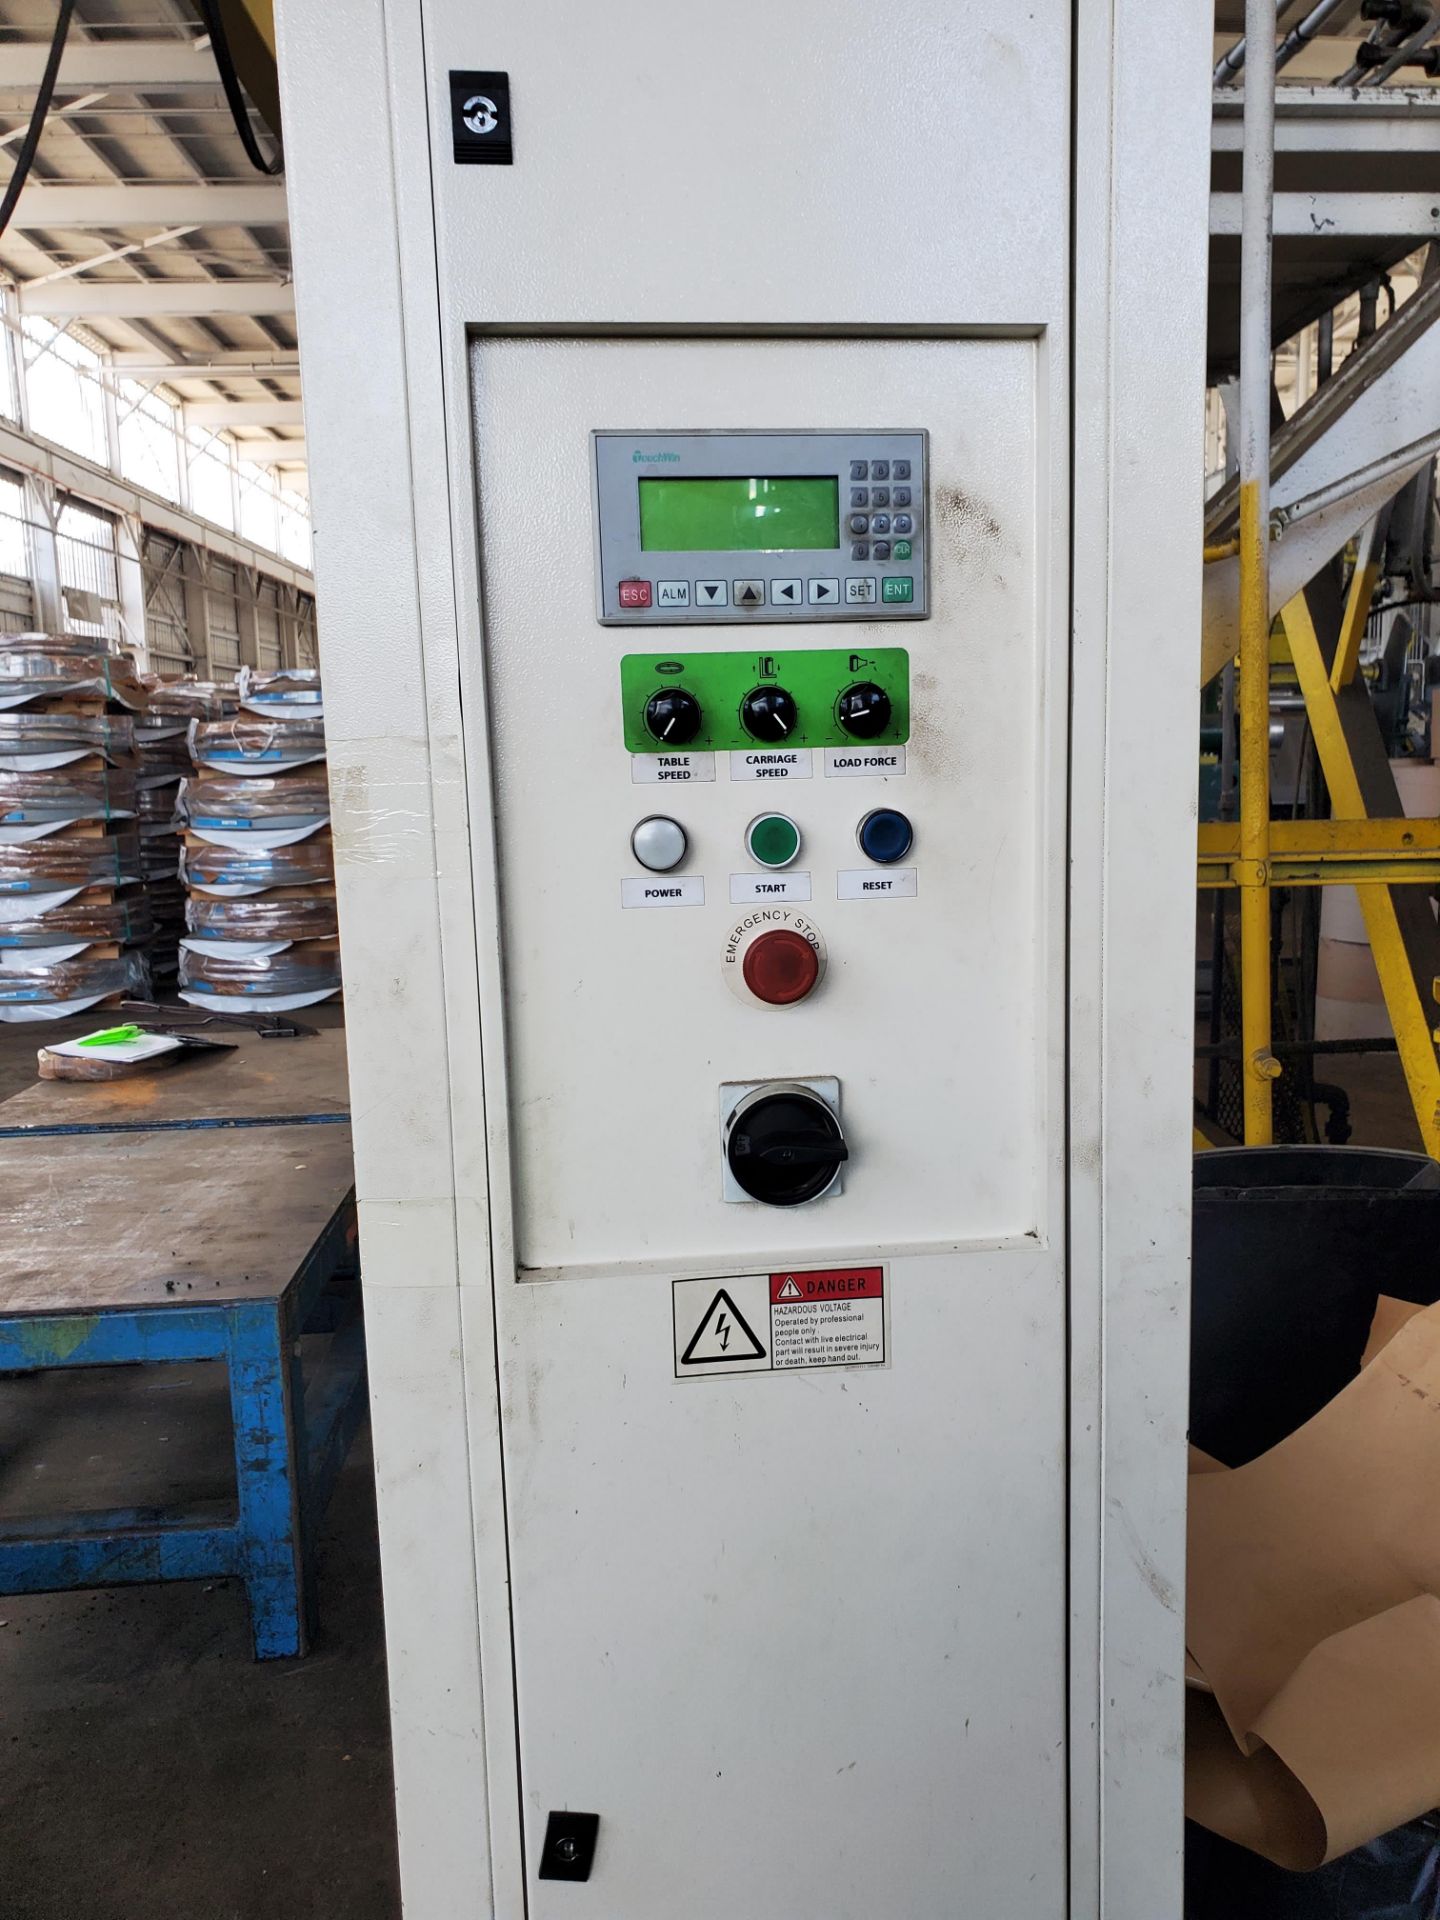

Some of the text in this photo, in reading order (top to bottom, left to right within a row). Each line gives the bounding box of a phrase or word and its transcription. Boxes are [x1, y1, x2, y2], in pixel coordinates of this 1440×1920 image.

[622, 584, 909, 601] ESC ALM SET ENT
[657, 757, 690, 767] TABLE
[745, 754, 798, 765] CARRIAGE
[833, 756, 897, 768] LOAD FORCE
[657, 769, 691, 780] SPEED
[755, 767, 789, 778] SPEED
[755, 884, 786, 893] START
[862, 881, 893, 891] RESET
[644, 888, 682, 898] POWER
[726, 910, 820, 963] EMERGENCY STOP
[807, 1278, 866, 1293] DANGER
[773, 1302, 851, 1315] HAZARDOUS VOLTAGE
[774, 1313, 864, 1327] Operated by professional
[775, 1328, 799, 1338] people
[775, 1333, 868, 1346] Contact with live electrical
[775, 1348, 790, 1357] part
[791, 1346, 803, 1355] will
[804, 1345, 825, 1354] result
[860, 1343, 880, 1351] injury
[809, 1356, 827, 1364] keep
[827, 1354, 846, 1362] hand
